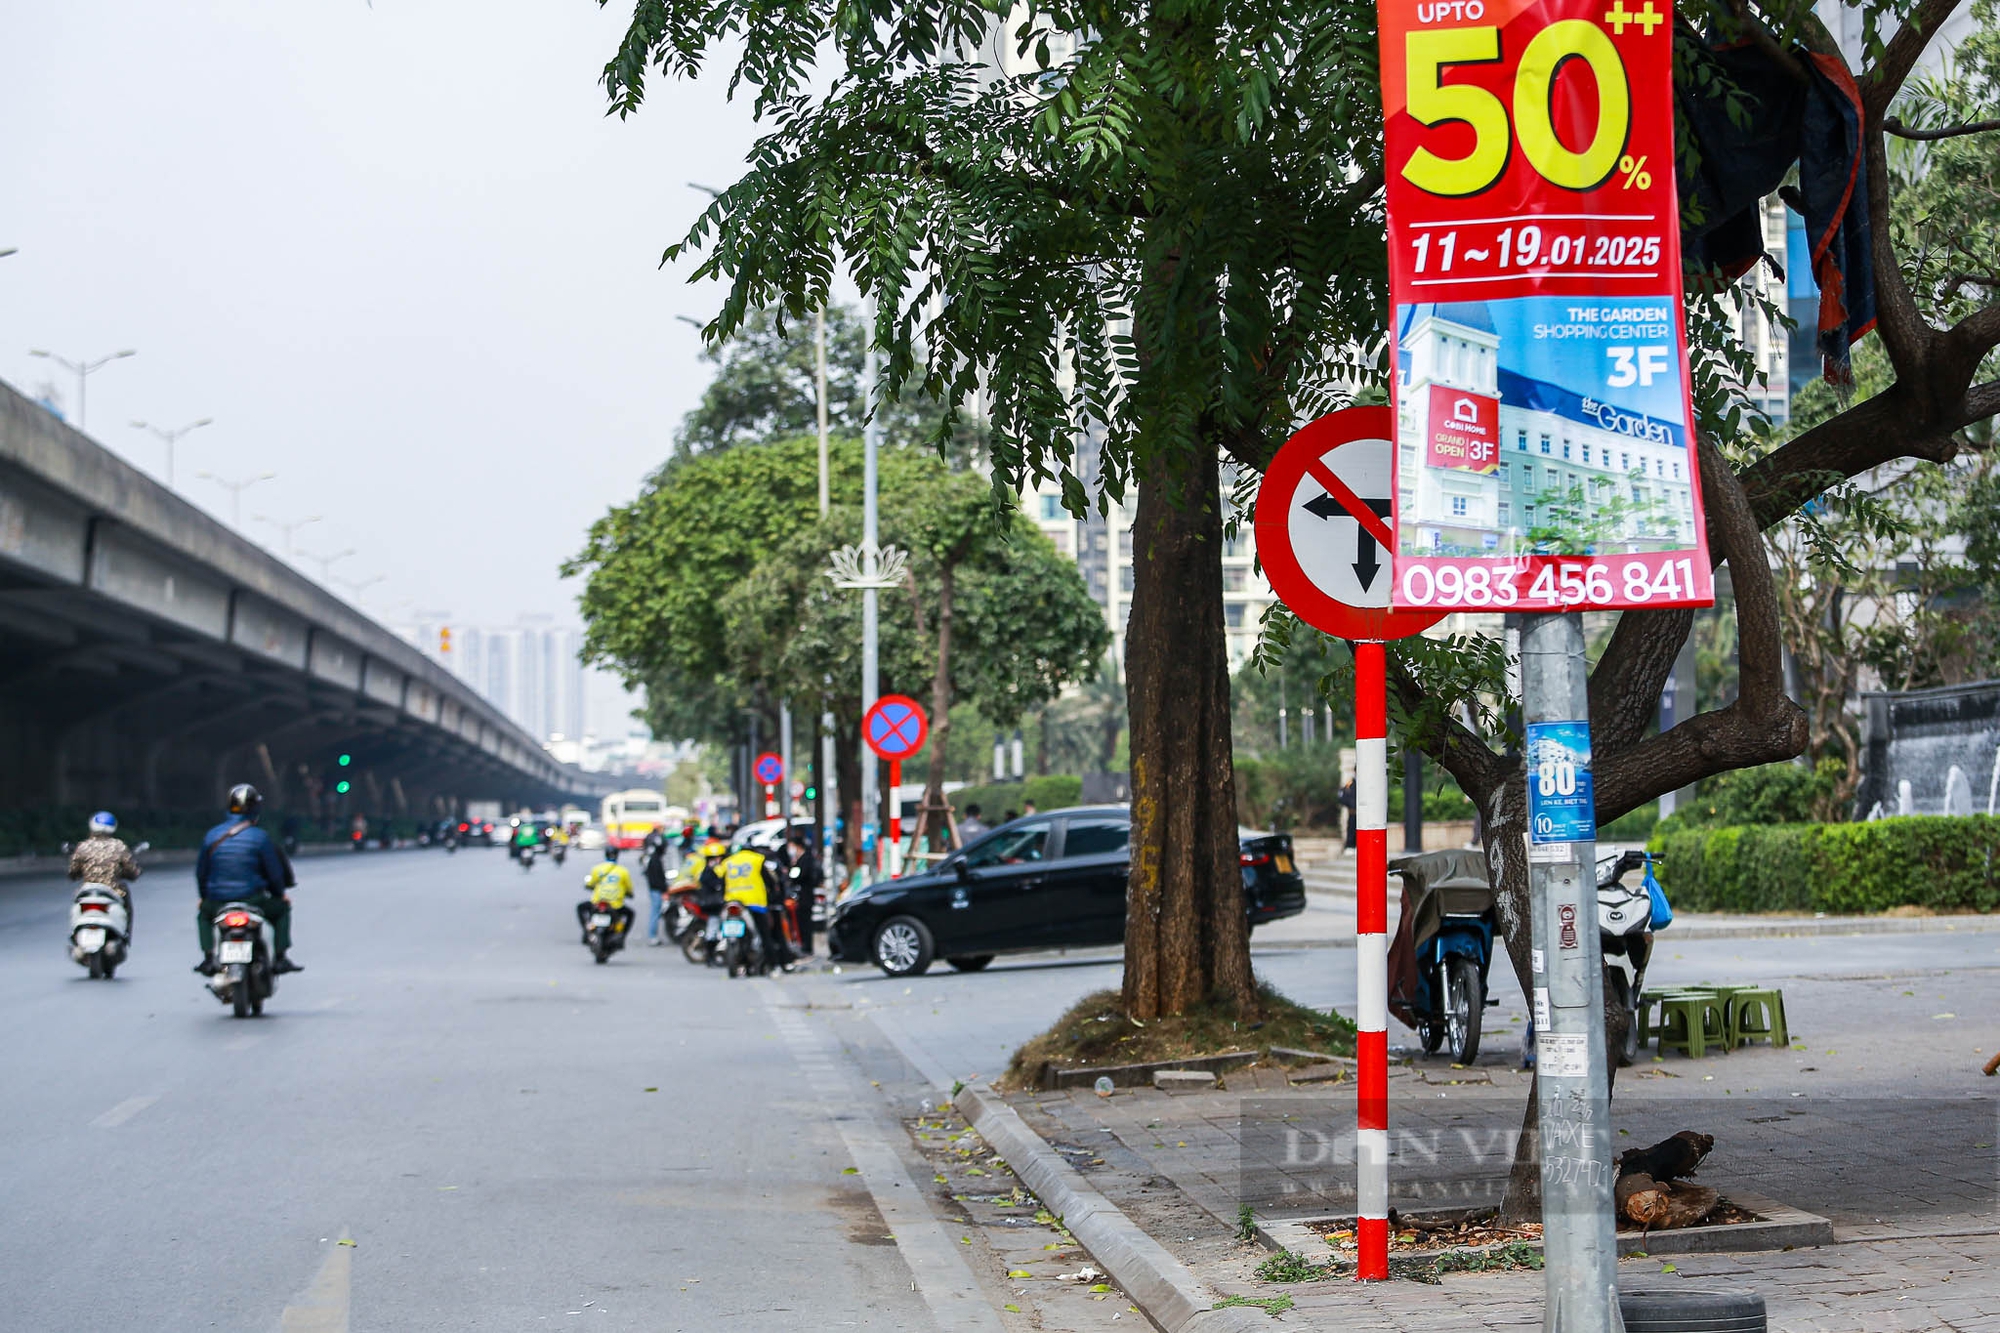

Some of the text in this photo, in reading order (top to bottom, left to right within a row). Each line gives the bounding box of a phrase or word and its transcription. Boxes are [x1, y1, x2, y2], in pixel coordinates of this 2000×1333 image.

[1567, 307, 1668, 322] THE GARDEN
[1533, 324, 1670, 339] SHOPPING CENTER
[1606, 345, 1668, 388] 3F
[1597, 403, 1673, 446] Garden
[1435, 433, 1466, 447] GRAND
[1435, 444, 1465, 458] OPEN
[1469, 440, 1495, 461] 3F
[1402, 558, 1697, 607] 0983 456 841
[1538, 762, 1576, 797] 80
[1537, 817, 1553, 834] 10
